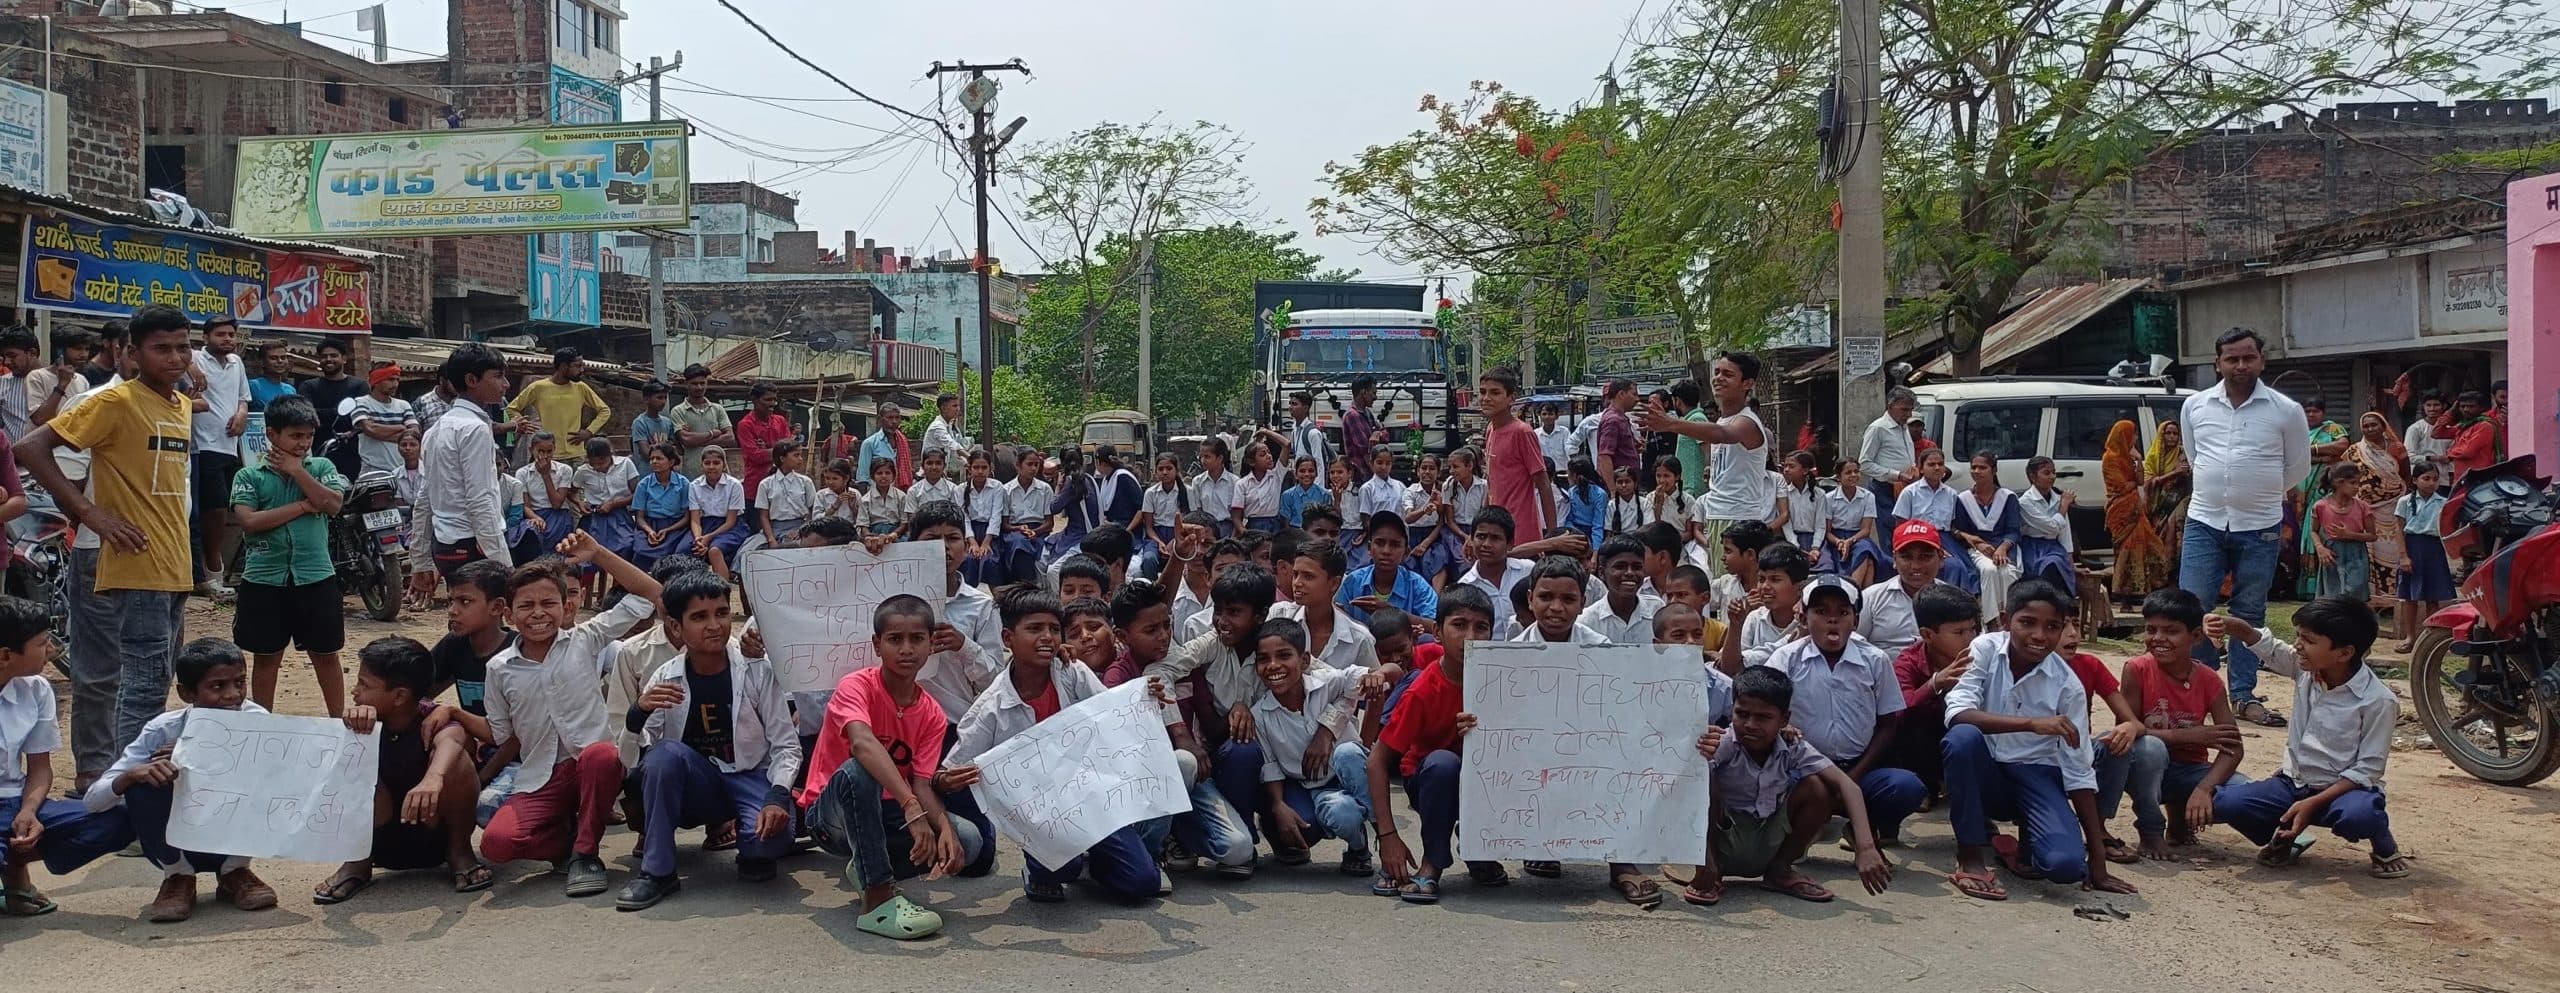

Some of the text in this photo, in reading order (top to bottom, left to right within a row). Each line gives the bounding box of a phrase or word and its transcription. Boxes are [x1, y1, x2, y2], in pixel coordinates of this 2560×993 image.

[326, 152, 441, 197] कार्ड
[432, 199, 470, 213] कार्ड
[35, 222, 74, 252] शादी
[85, 272, 119, 304] फोटो
[151, 279, 185, 311] हिन्दी
[326, 299, 366, 327] स्टोर
[1903, 524, 1928, 535] ACC
[1639, 720, 1691, 763] के
